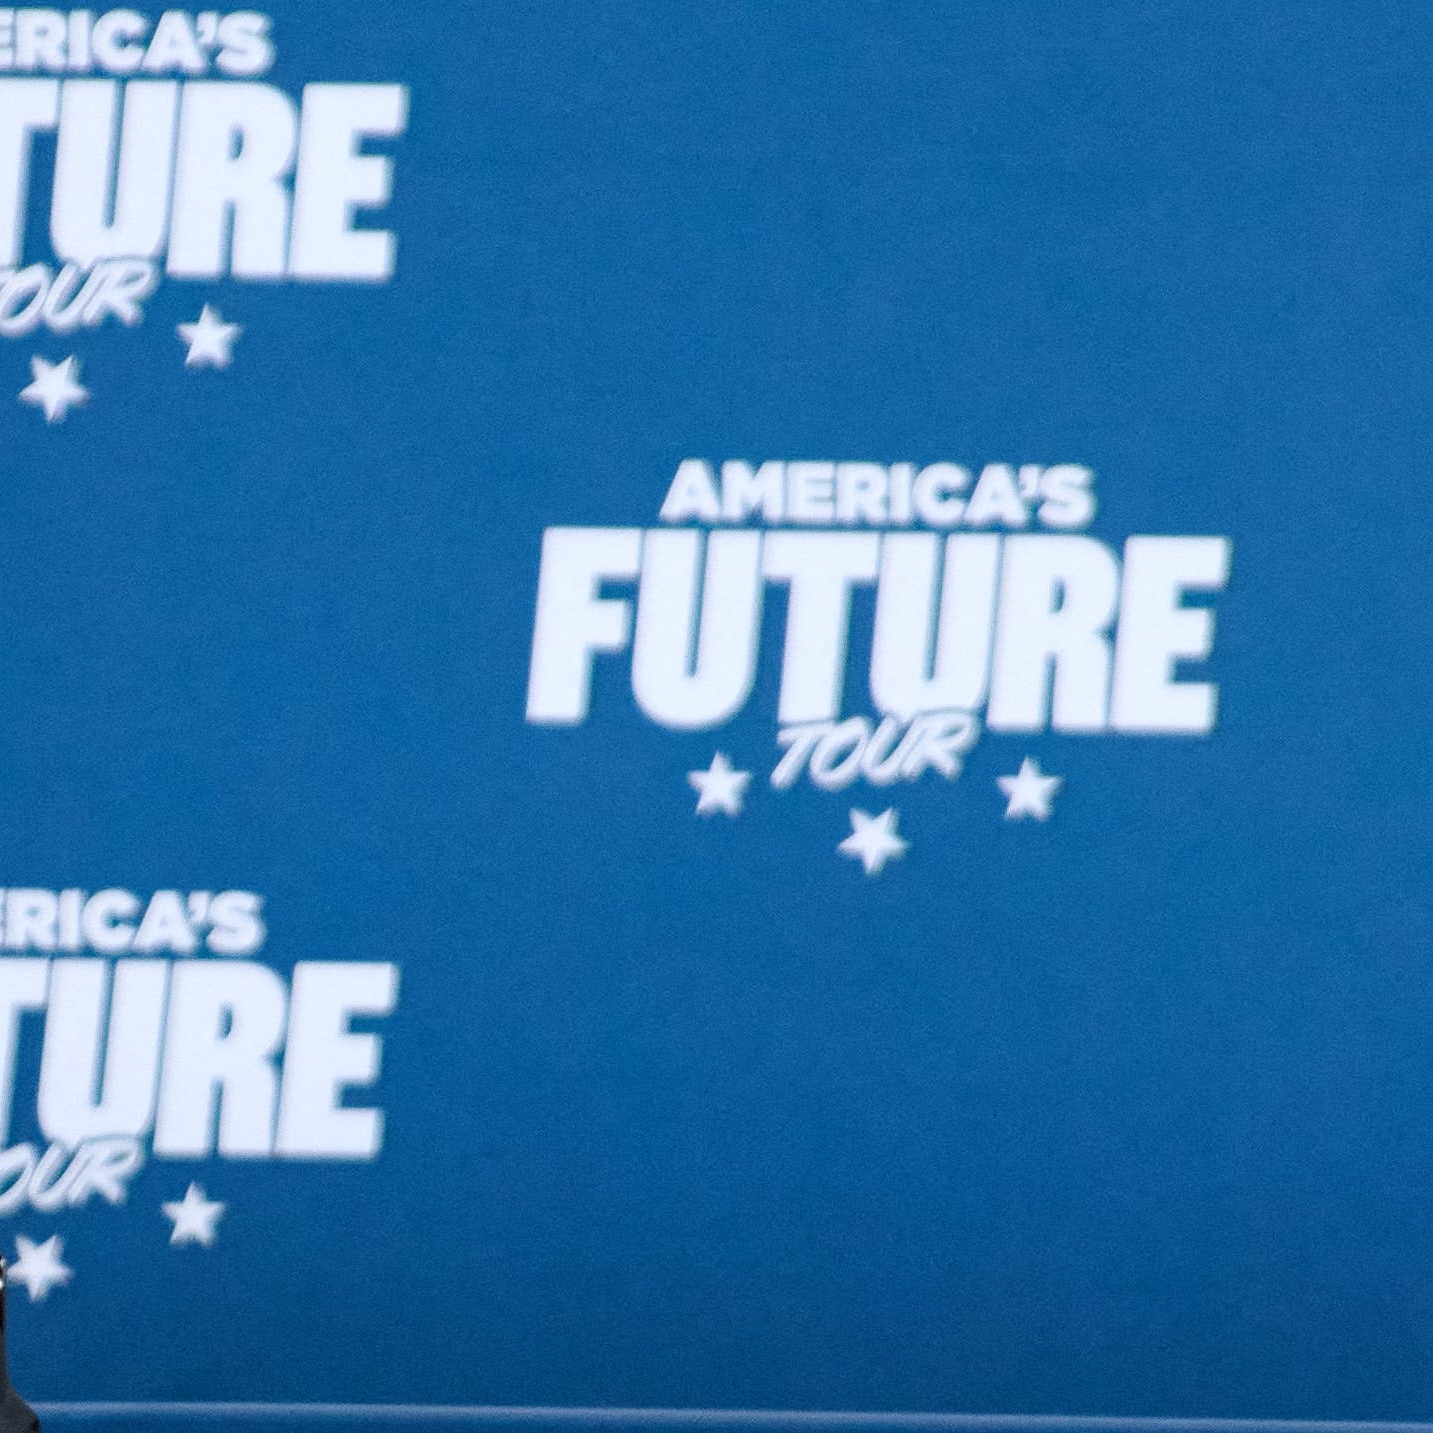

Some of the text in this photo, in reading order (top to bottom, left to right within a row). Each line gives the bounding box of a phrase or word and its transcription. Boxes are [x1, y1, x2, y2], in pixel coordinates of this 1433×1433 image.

[658, 458, 1097, 528] AMERICA'S
[524, 526, 1232, 736] FUTURE
[769, 705, 980, 792] TOUR
